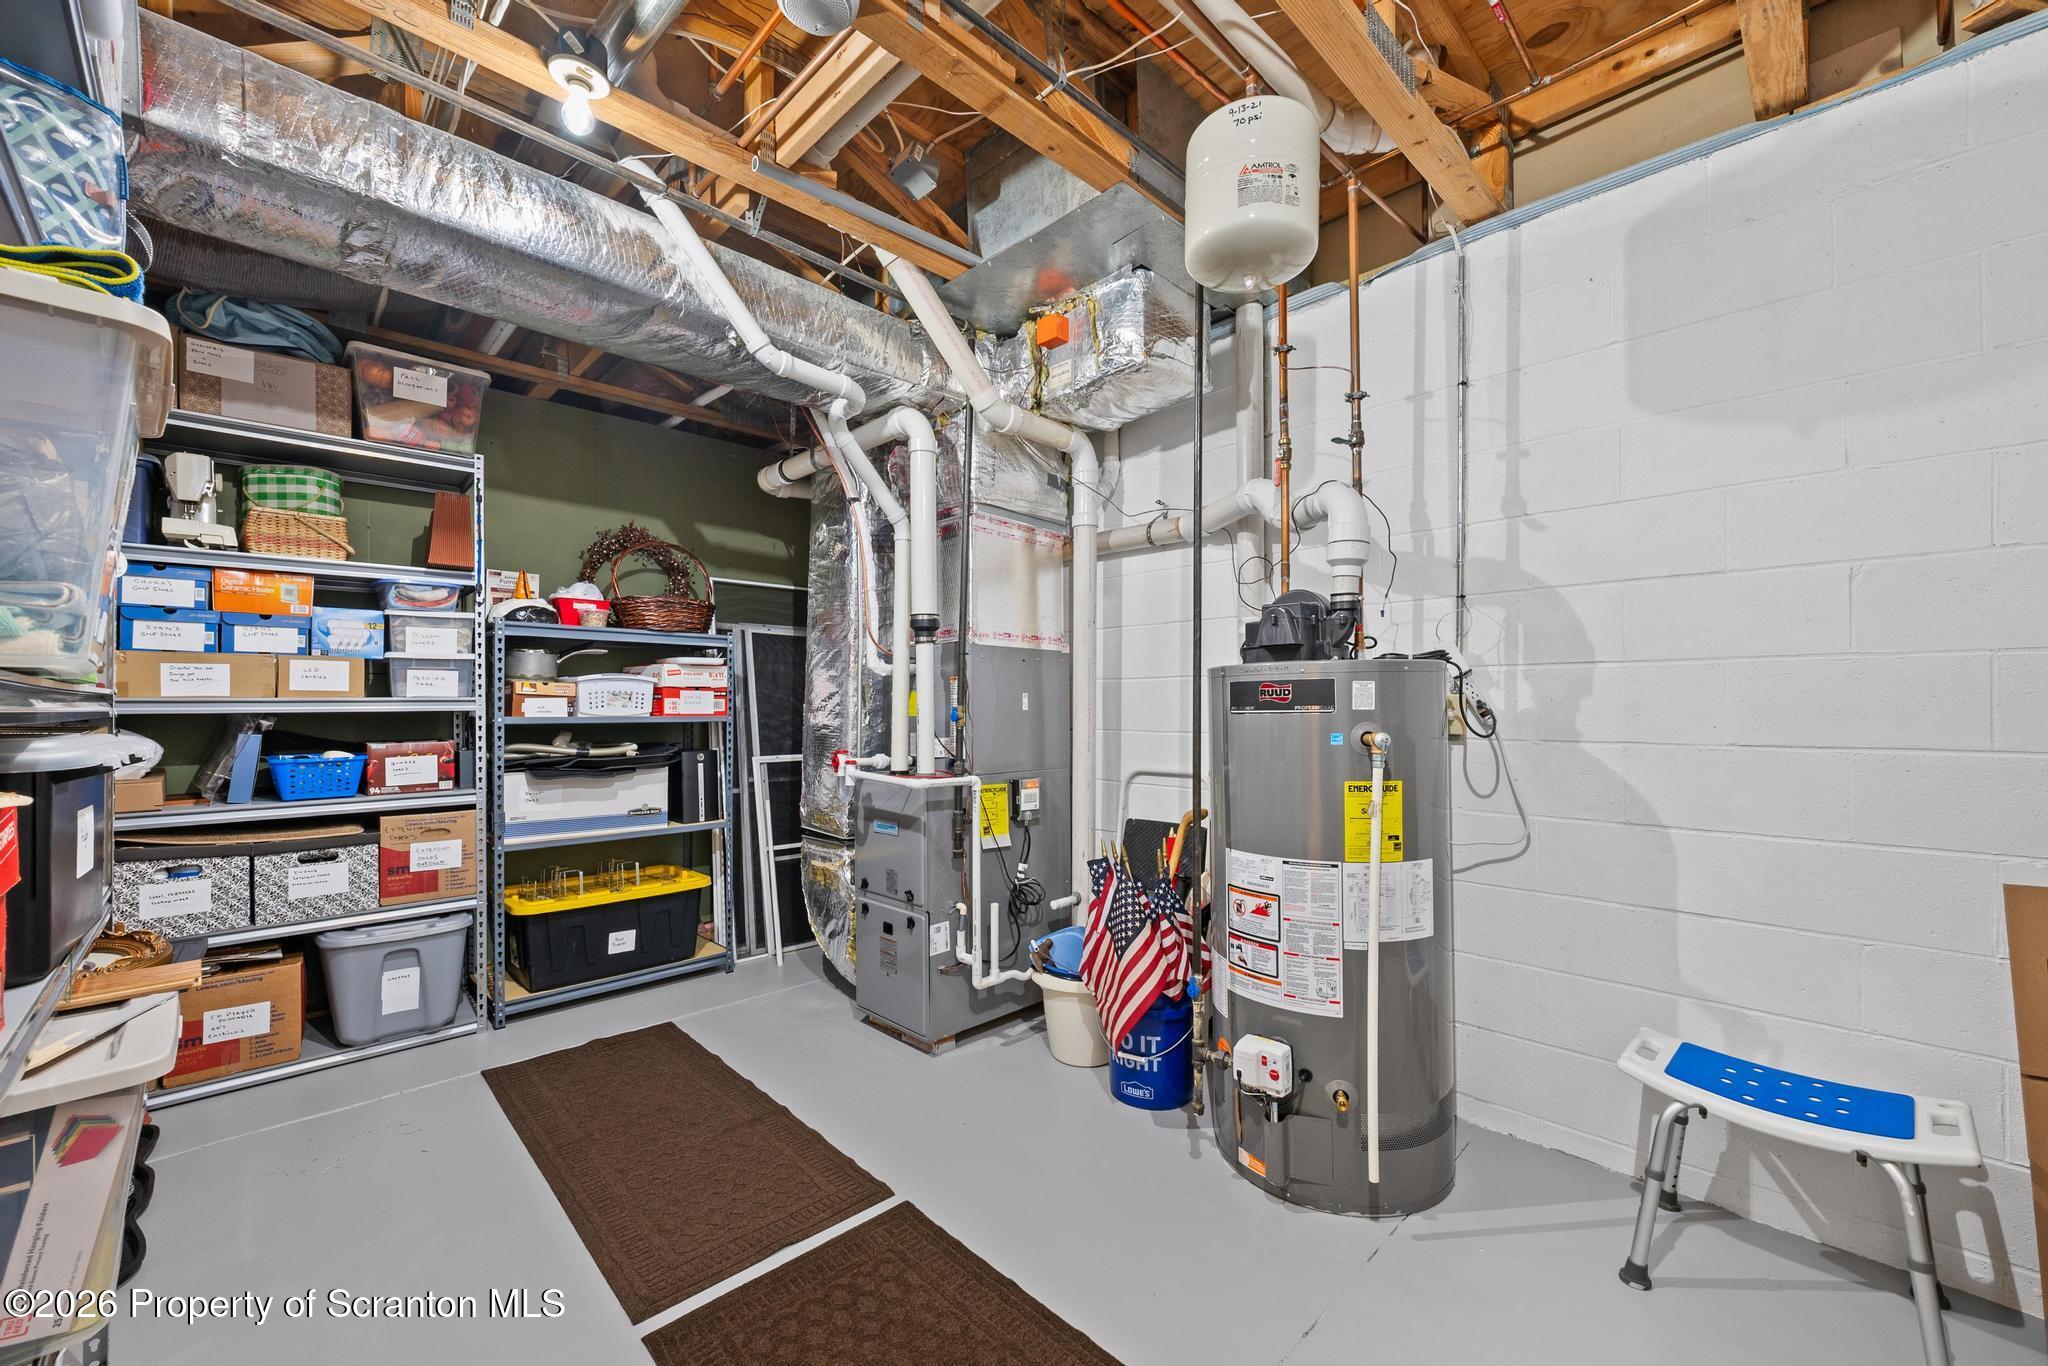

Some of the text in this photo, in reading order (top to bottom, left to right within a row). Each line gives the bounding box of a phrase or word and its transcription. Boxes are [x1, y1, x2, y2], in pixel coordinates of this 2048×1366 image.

[1228, 101, 1262, 117] 9-13-21
[1233, 112, 1262, 126] 70 psi
[401, 372, 421, 381] FALL
[221, 584, 275, 594] Ceramic Heater
[367, 622, 377, 630] 12
[1260, 688, 1291, 697] RUUD
[1348, 784, 1398, 793] ENERGUIDE
[196, 976, 263, 992] Lowes.com/Moving
[1121, 1033, 1161, 1054] O IT
[1123, 1084, 1150, 1097] LOWE'S
[26, 1226, 43, 1254] Hanging
[35, 1202, 49, 1227] Folders
[52, 1318, 63, 1328] 25
